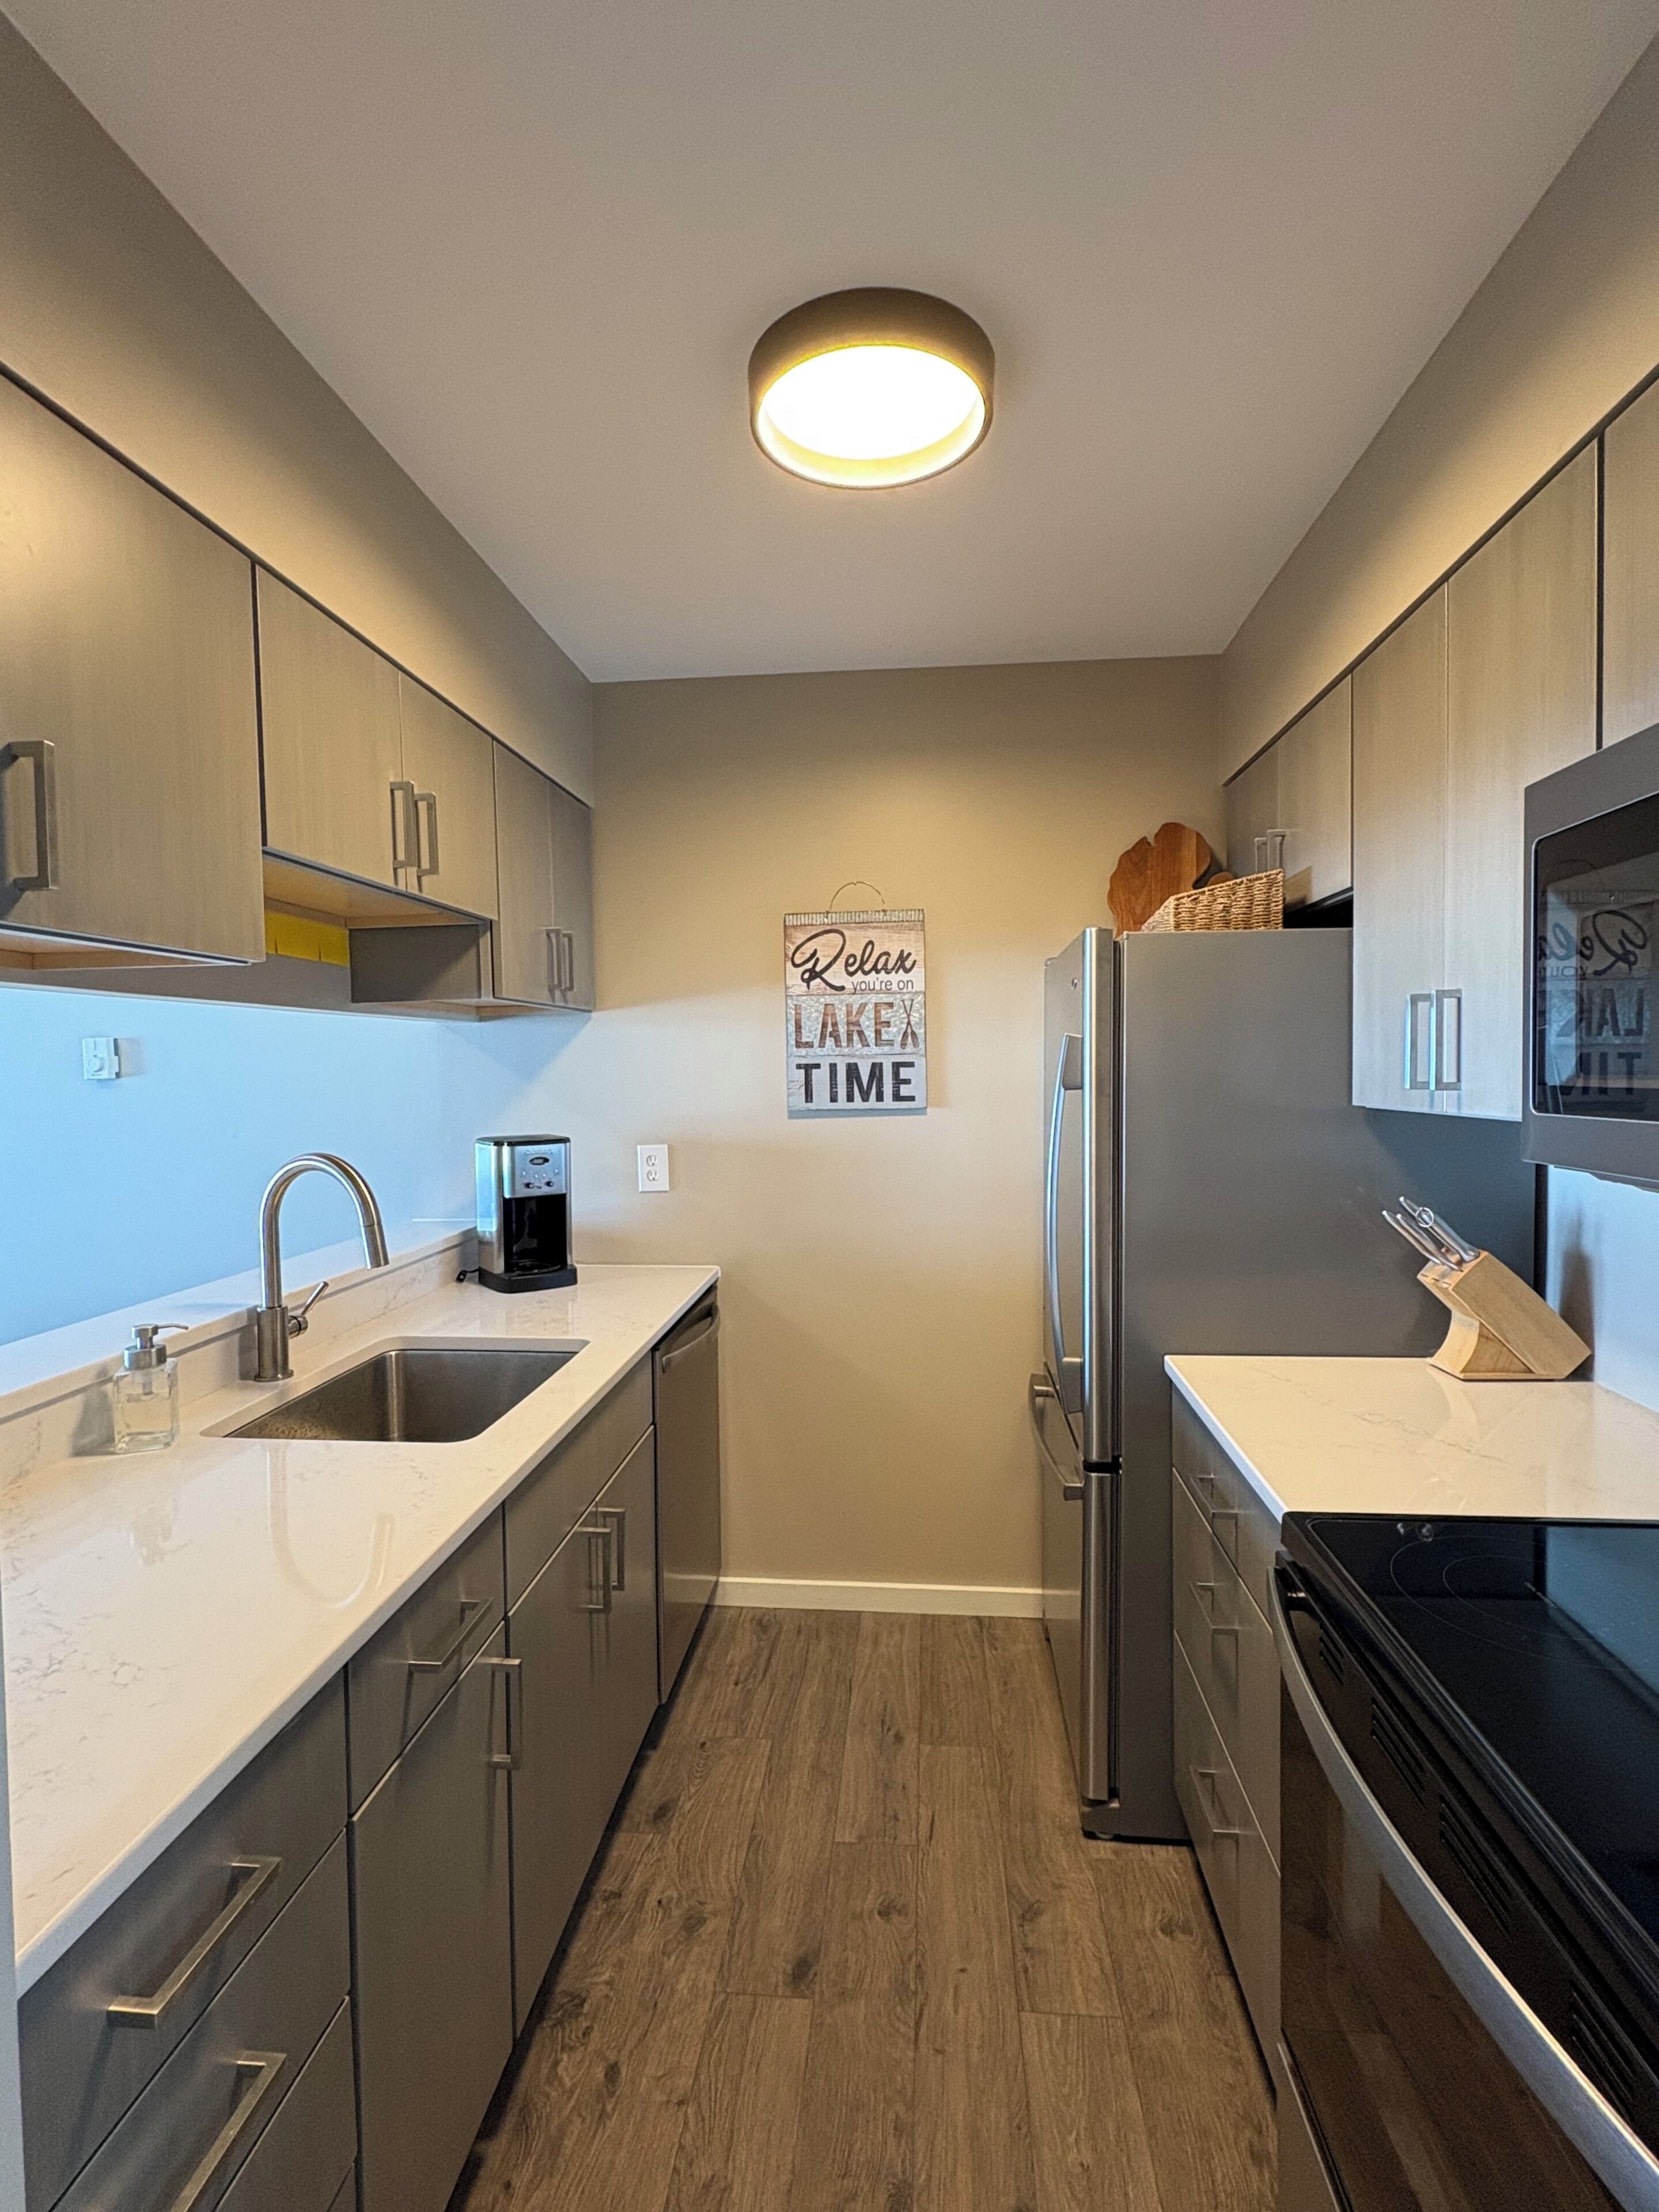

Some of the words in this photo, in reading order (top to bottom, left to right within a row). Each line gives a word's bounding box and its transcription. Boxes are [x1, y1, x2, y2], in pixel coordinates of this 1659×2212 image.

[791, 929, 916, 991] Relax
[851, 977, 893, 994] you're
[897, 980, 914, 991] on
[794, 1002, 895, 1048] LAKE
[796, 1061, 916, 1103] TIME
